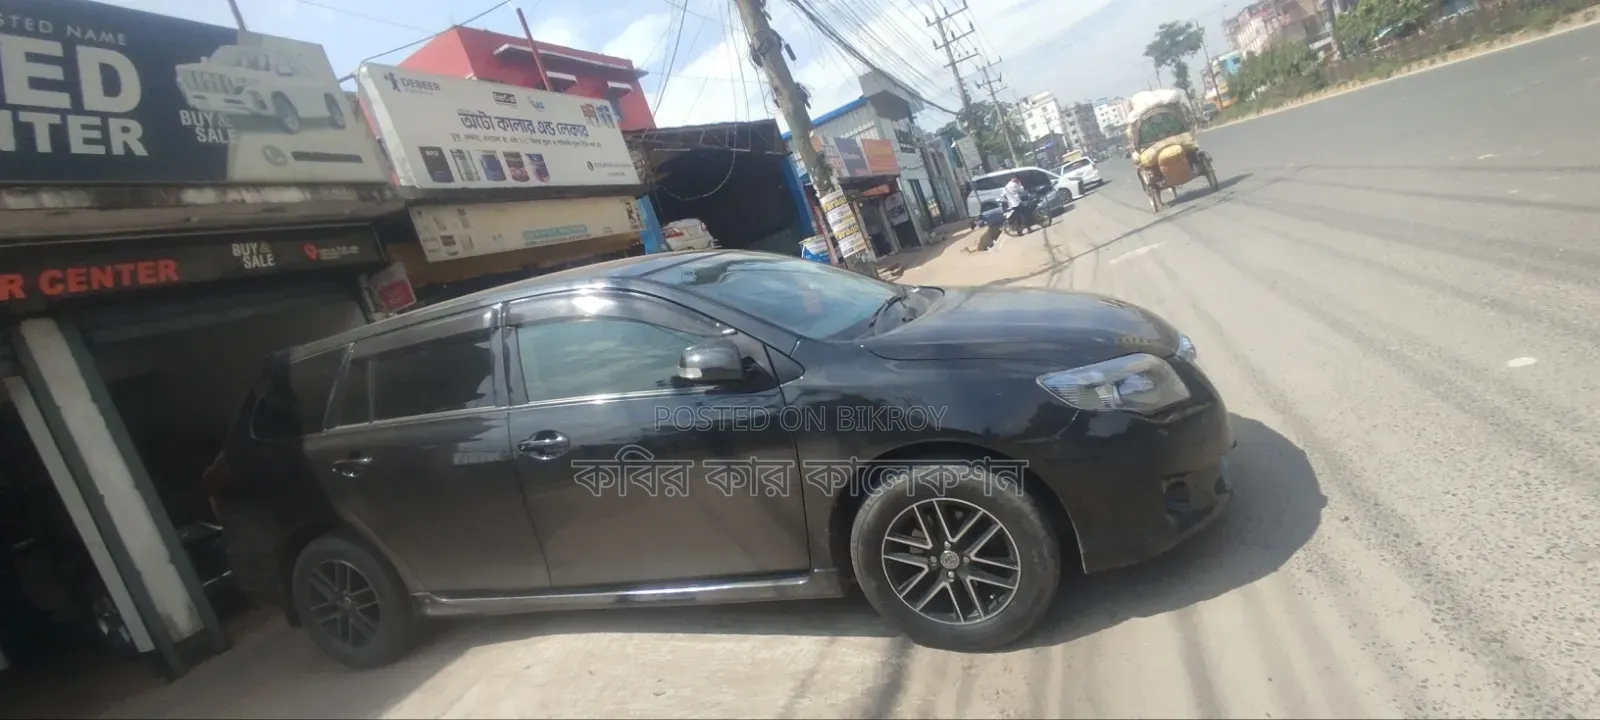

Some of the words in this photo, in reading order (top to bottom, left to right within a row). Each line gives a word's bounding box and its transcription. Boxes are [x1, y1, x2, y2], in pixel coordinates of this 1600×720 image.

[66, 24, 128, 46] NAME
[0, 33, 142, 114] ED
[179, 109, 214, 127] BUY
[493, 116, 536, 135] কালার
[556, 122, 589, 138] লেকার
[195, 126, 236, 144] SALE
[232, 242, 257, 257] BUY
[242, 253, 276, 269] SALE
[38, 258, 180, 296] CENTER
